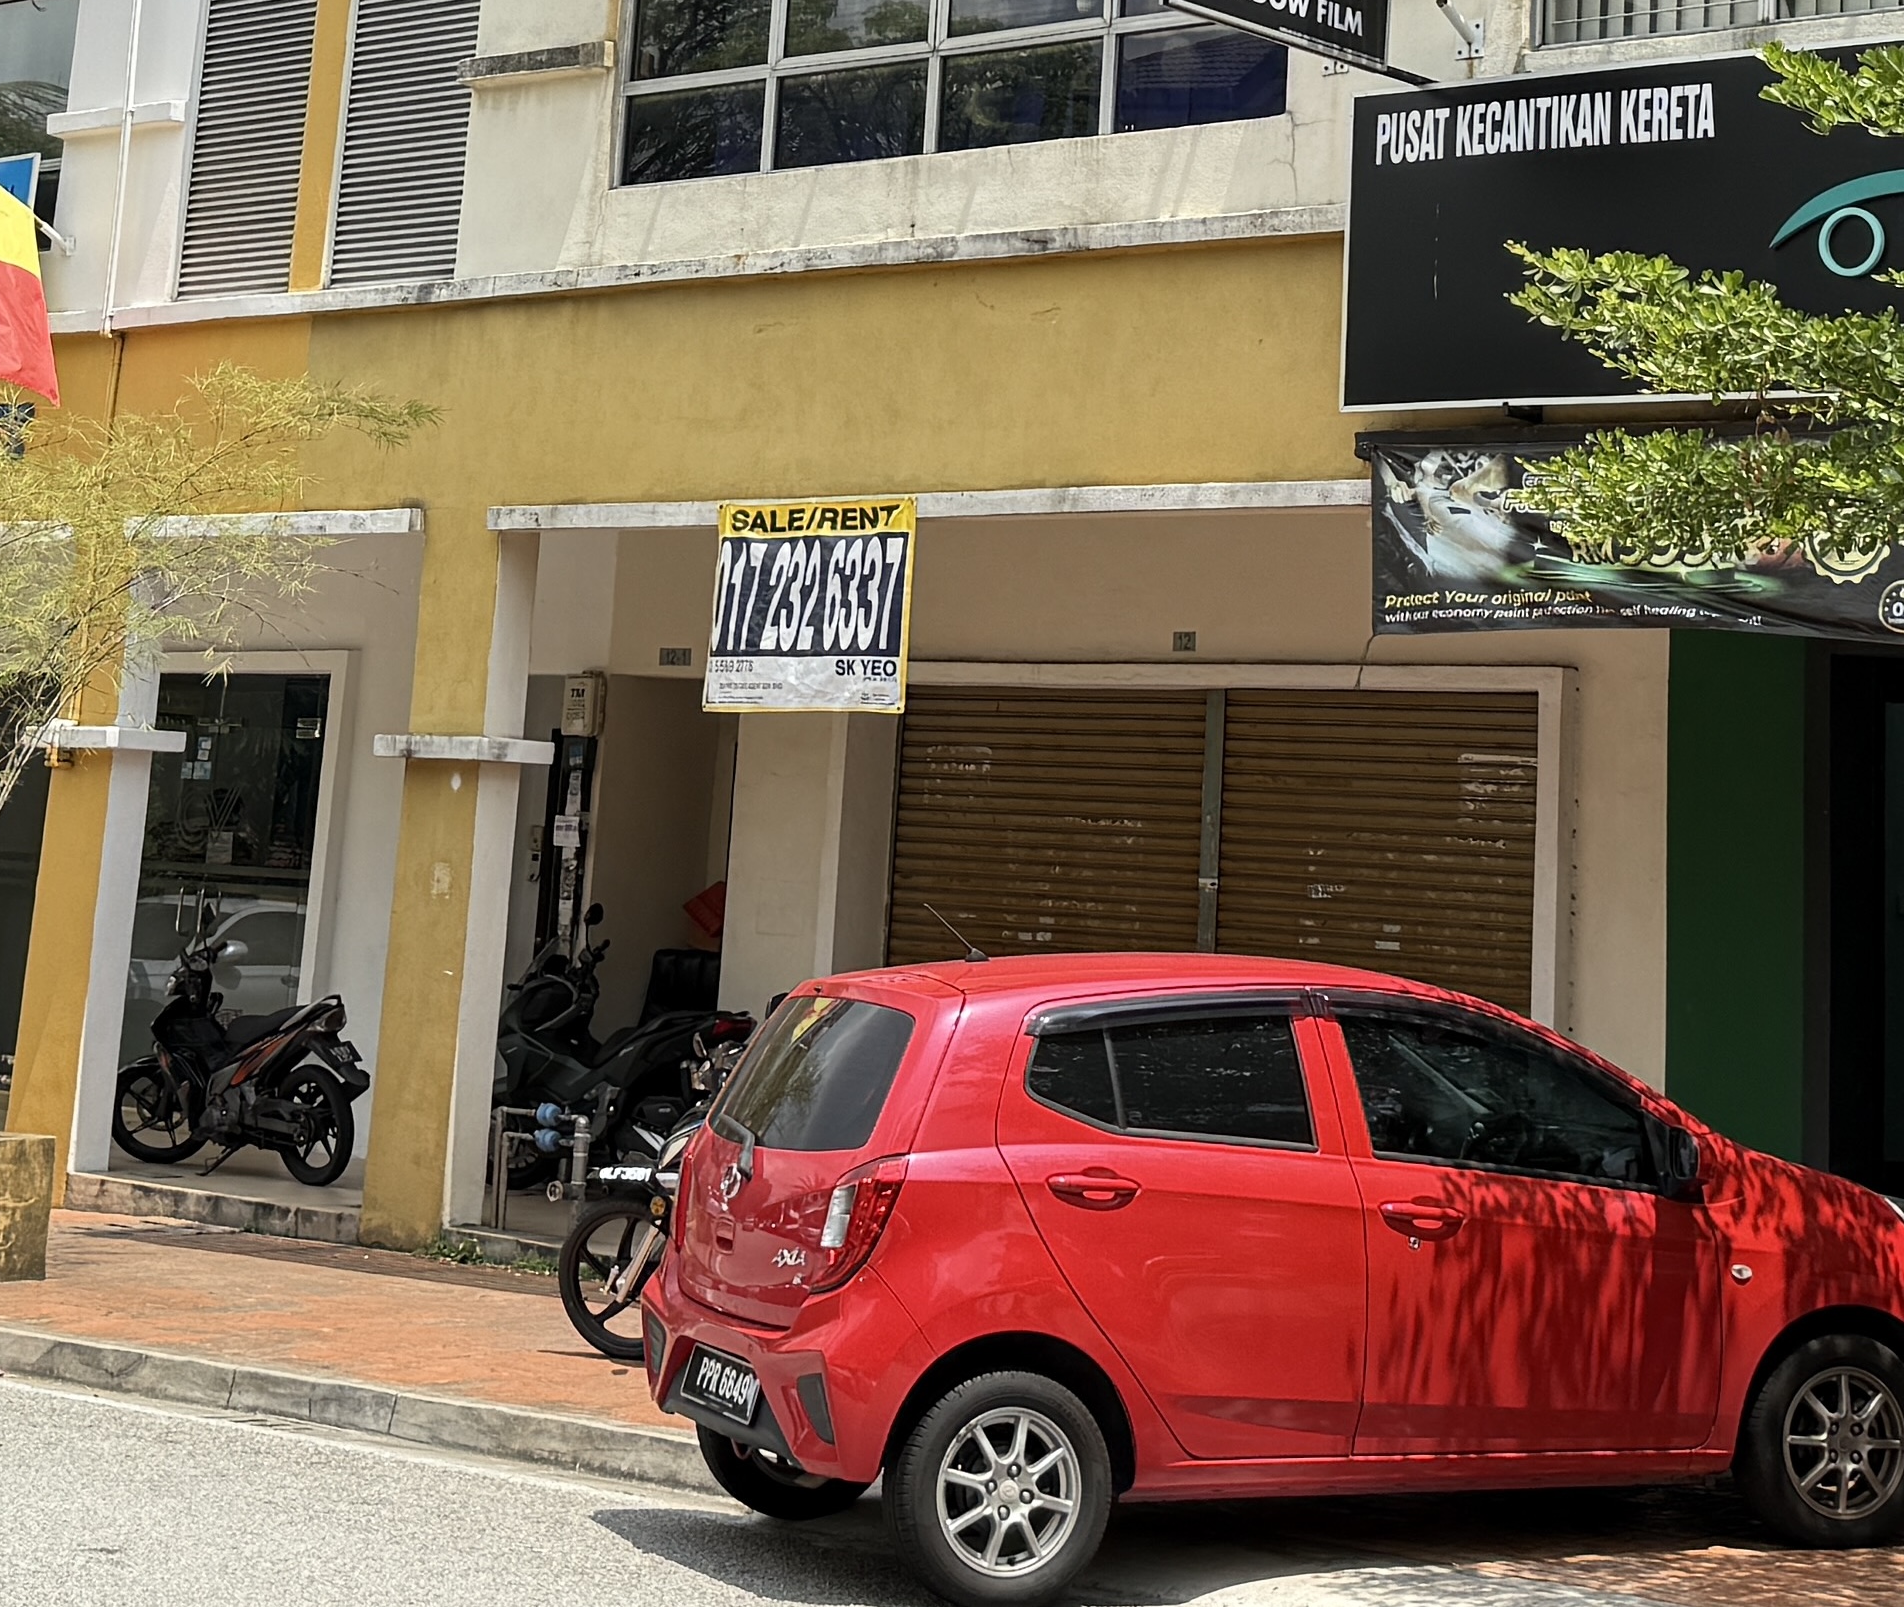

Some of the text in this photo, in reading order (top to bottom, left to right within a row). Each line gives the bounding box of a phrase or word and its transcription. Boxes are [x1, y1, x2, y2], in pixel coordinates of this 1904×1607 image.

[1375, 83, 1716, 166] PUSAT KECANTIKAN KERETA
[731, 505, 900, 532] SALE/RENT
[760, 539, 821, 651] 232
[823, 536, 904, 651] 6337
[1385, 591, 1440, 608] Protect
[1445, 589, 1489, 604] Your
[1491, 589, 1551, 606] original
[1432, 607, 1493, 620] economy
[1494, 607, 1529, 619] paint
[835, 659, 897, 677] SK YEO
[697, 1356, 751, 1406] PPR 6649
